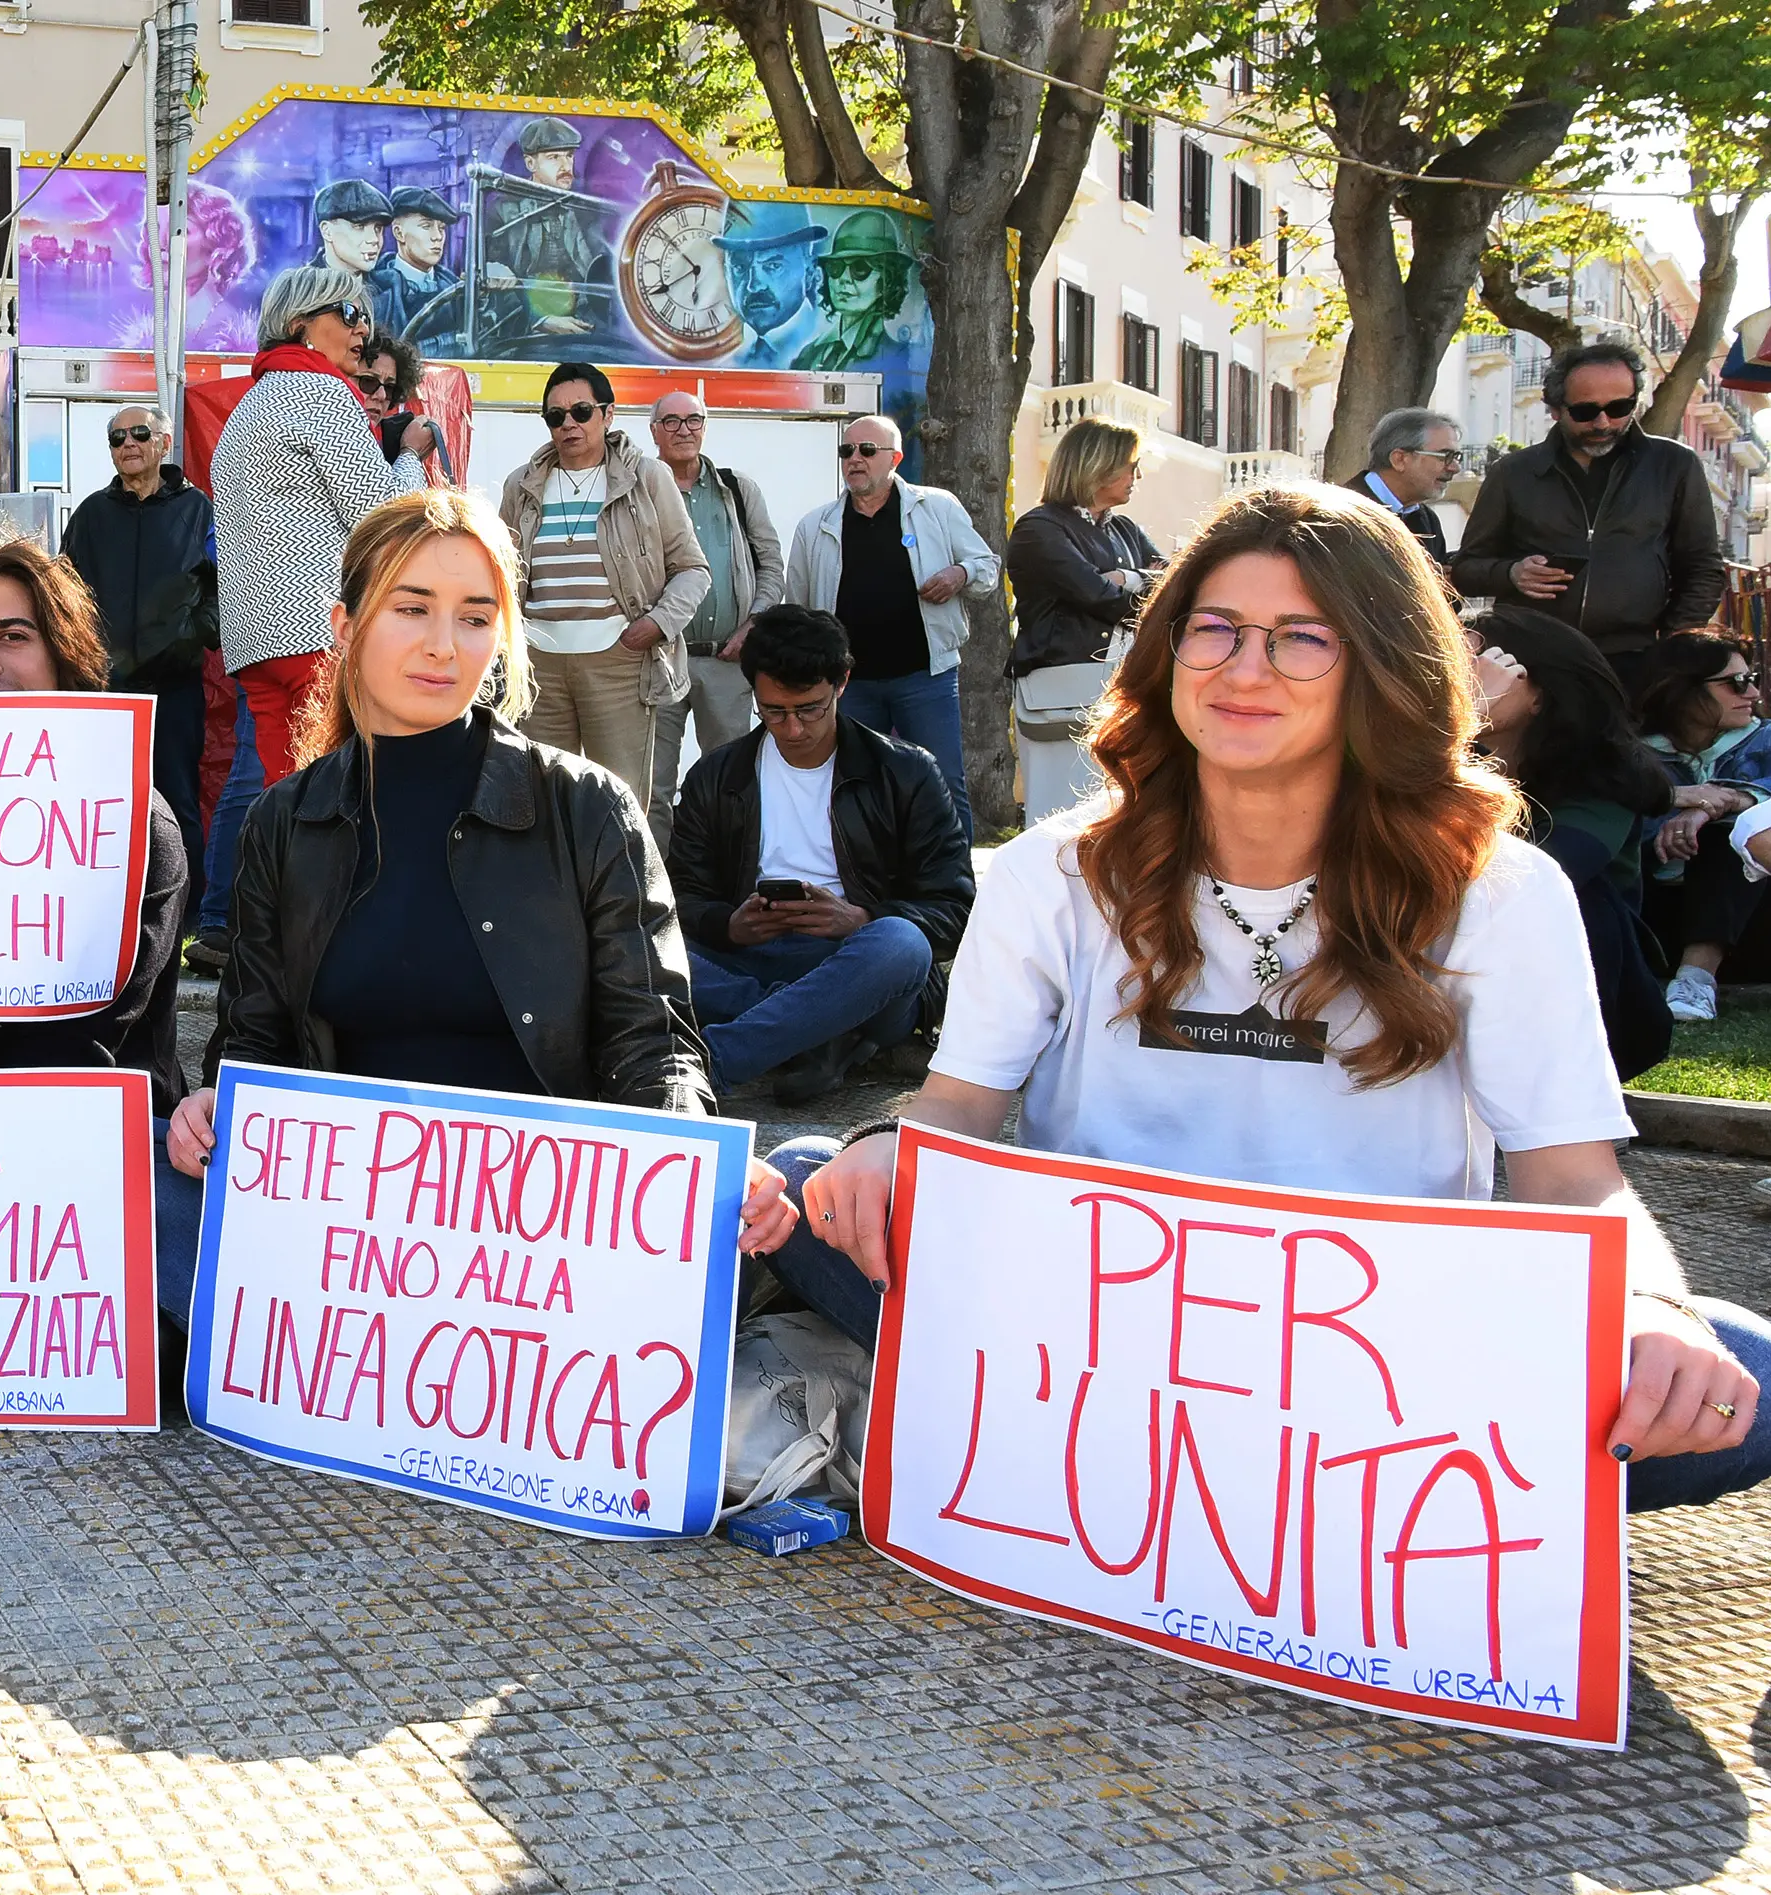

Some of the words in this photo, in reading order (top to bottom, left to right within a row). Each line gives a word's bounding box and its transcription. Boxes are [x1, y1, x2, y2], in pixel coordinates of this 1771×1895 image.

[54, 980, 114, 1002] URBANA
[232, 1112, 356, 1201] SIETE
[365, 1111, 701, 1262] PATRIOTTICI
[321, 1226, 440, 1298] FINO
[454, 1245, 574, 1313] ALLA
[1070, 1191, 1404, 1426] PER
[222, 1286, 386, 1428] LINEA
[405, 1320, 695, 1511] GOTICA?
[562, 1487, 650, 1520] URBANA
[938, 1343, 1544, 1682] L'UNITÀ
[1411, 1667, 1565, 1714] URBANA
